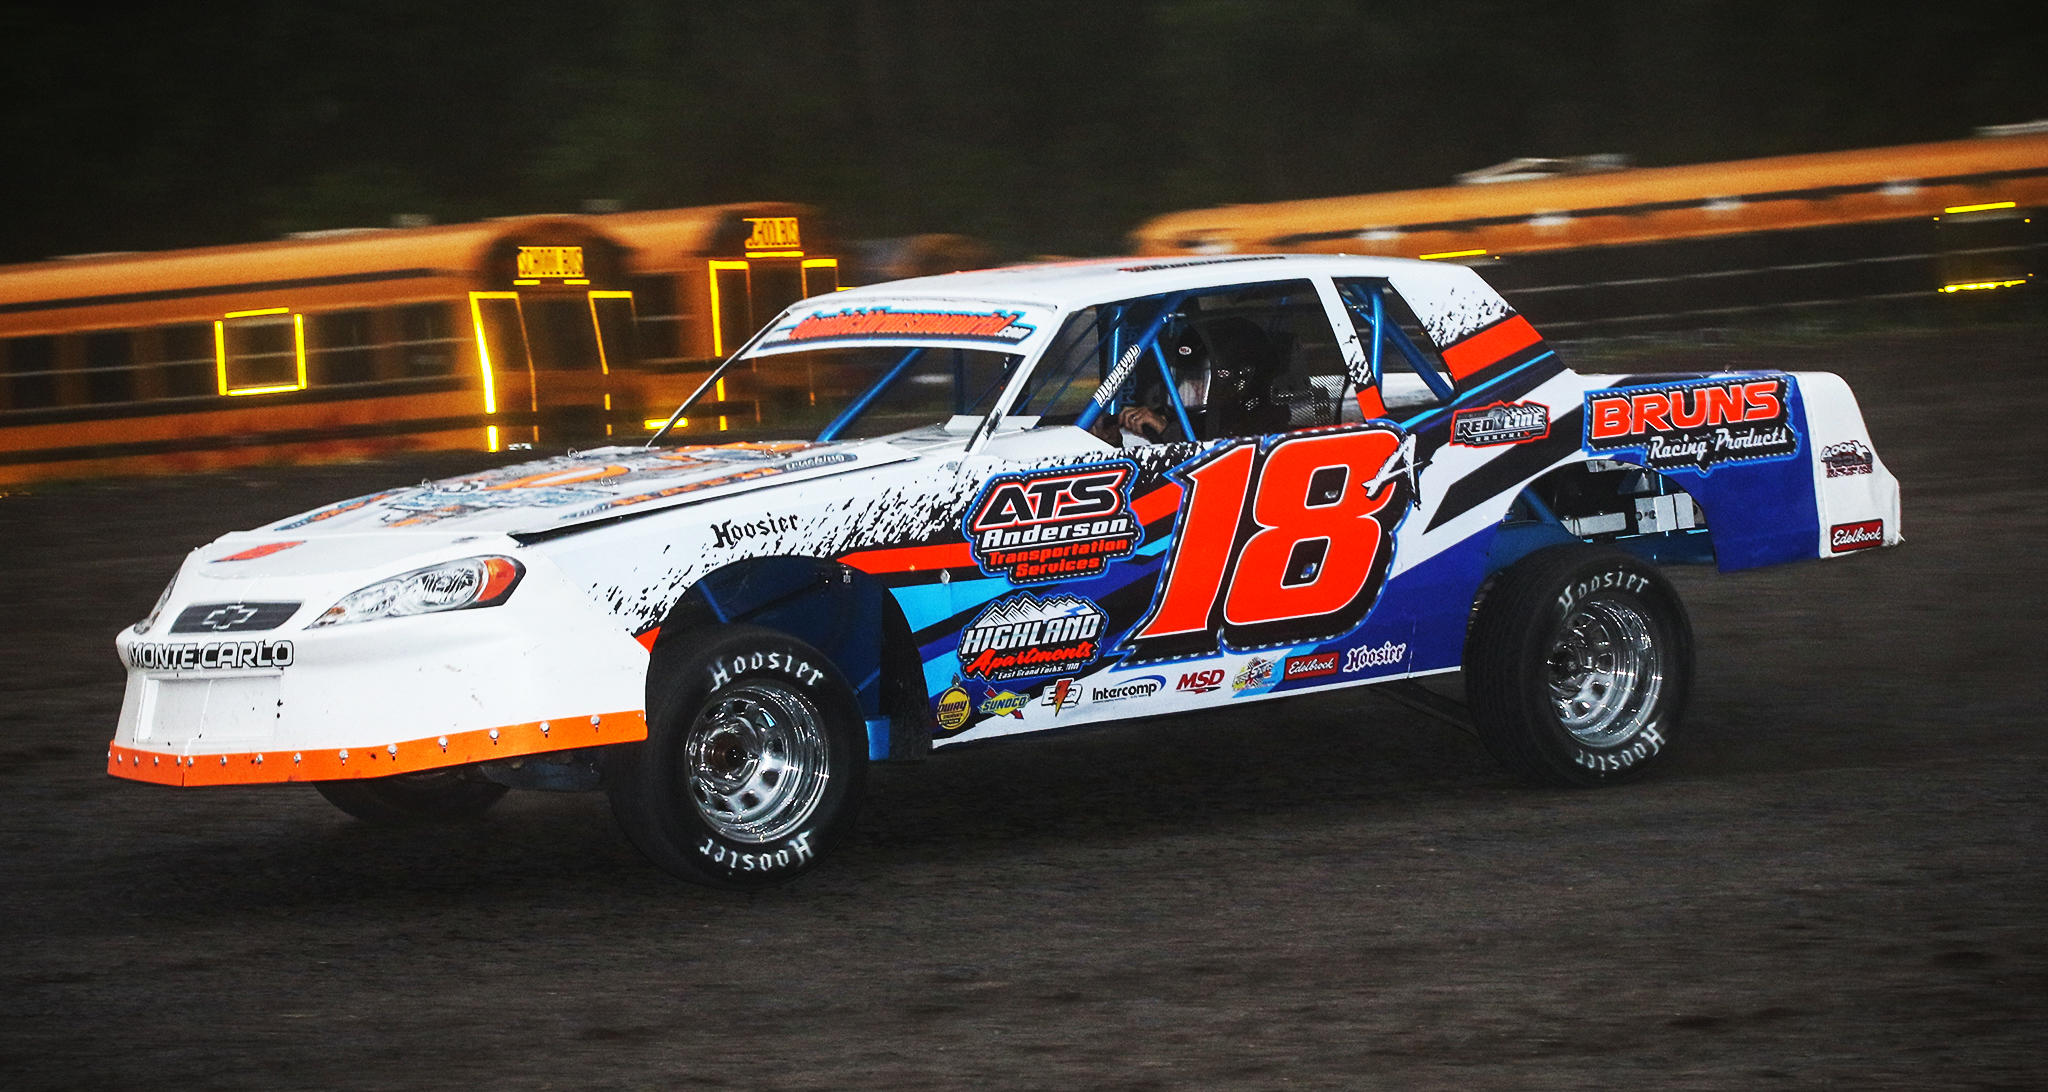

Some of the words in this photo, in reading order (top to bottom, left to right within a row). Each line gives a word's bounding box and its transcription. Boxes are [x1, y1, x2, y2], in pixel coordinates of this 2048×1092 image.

[1592, 381, 1779, 439] BRUNS
[1650, 438, 1708, 460] Racing
[1715, 427, 1788, 452] Products
[975, 470, 1127, 531] ATS
[710, 511, 799, 547] Hoosier
[982, 518, 1128, 549] Anderson
[1135, 430, 1400, 638] 18
[1832, 526, 1881, 547] Edelbrock
[989, 539, 1128, 566] Transportation
[1015, 557, 1100, 578] Services
[1557, 566, 1649, 618] Hoosier
[961, 613, 1101, 655] HIGHLAND
[128, 642, 199, 670] MONTE
[201, 640, 295, 669] CARLO
[710, 648, 824, 692] Hoosier
[966, 641, 1093, 677] Apartments
[1288, 658, 1334, 675] Edelbrock
[1343, 641, 1406, 673] Hoosier
[1092, 683, 1157, 701] Intercomp
[1176, 669, 1225, 690] MSD
[982, 696, 1027, 711] SUNOCO
[1575, 721, 1666, 771] Hoosier
[699, 831, 814, 871] Hoosier
